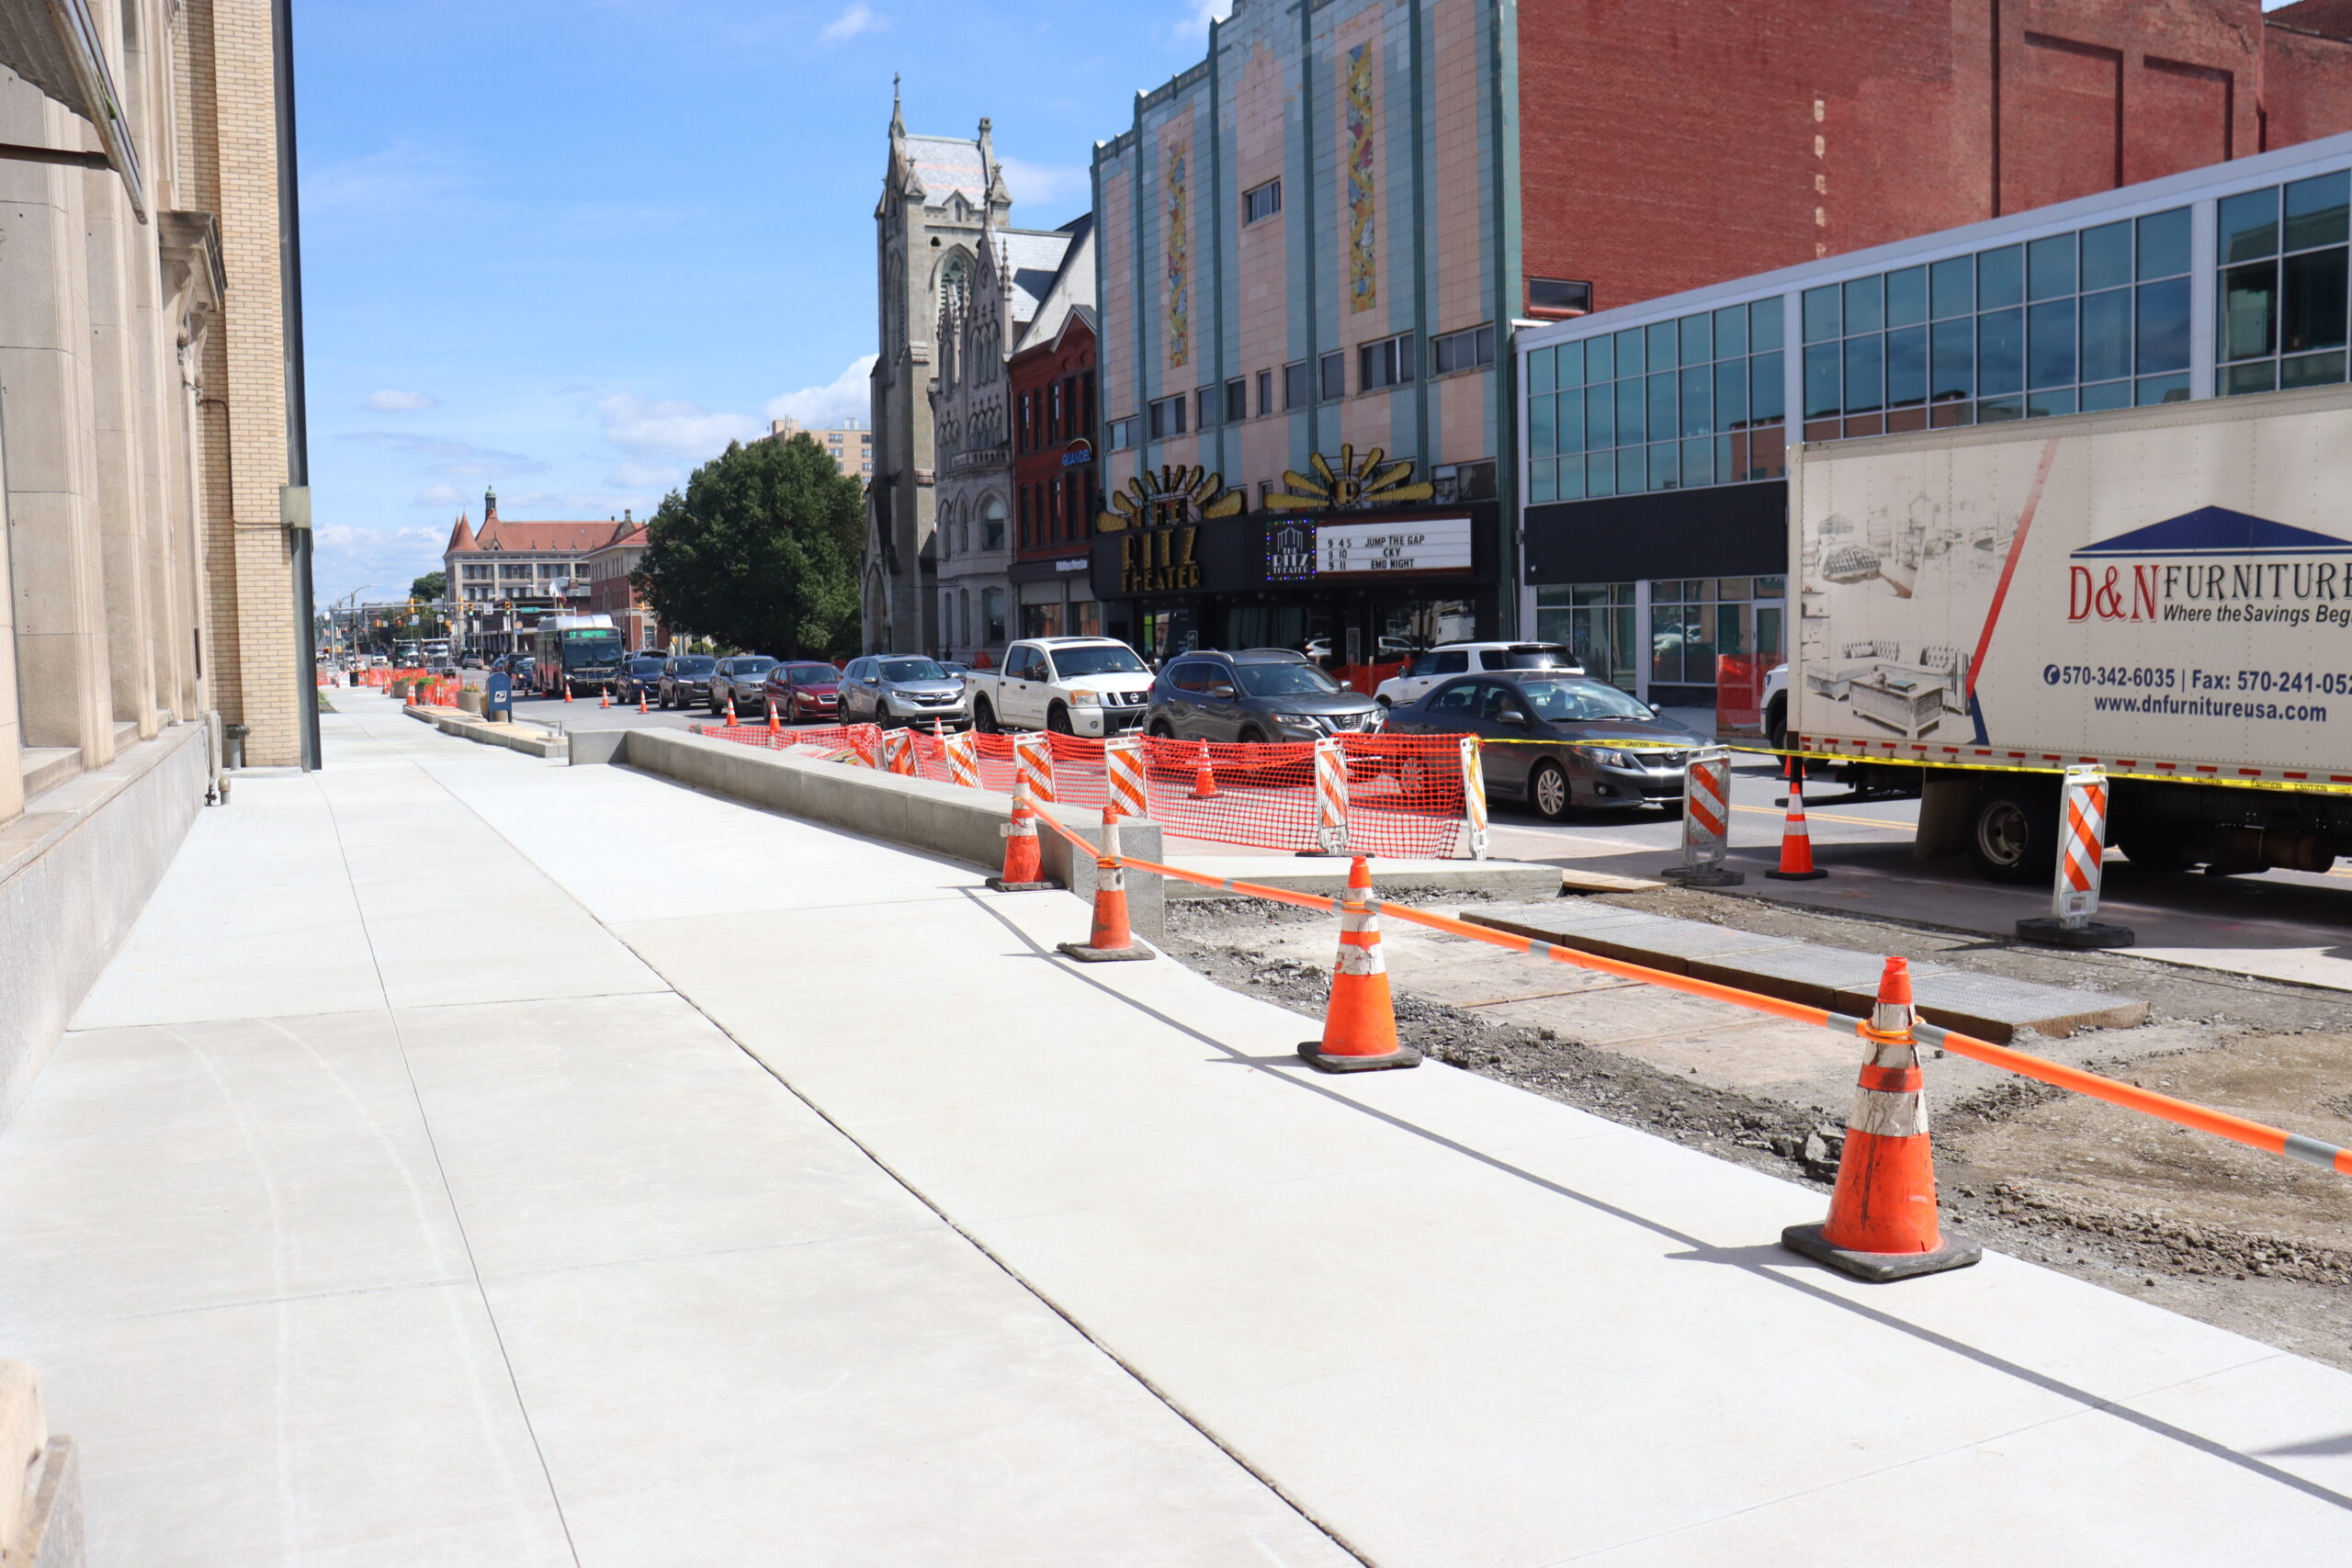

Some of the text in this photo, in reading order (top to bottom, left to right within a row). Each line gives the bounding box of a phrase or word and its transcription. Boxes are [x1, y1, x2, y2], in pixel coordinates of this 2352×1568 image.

[1062, 449, 1091, 466] QUANDEL
[1122, 526, 1196, 570] RITZ
[1340, 549, 1347, 558] 10
[1384, 547, 1401, 558] CKY
[1365, 537, 1385, 547] JUMP
[1388, 536, 1404, 546] THE
[1408, 535, 1425, 545] GAP
[1272, 554, 1308, 567] RITZ
[1371, 559, 1387, 570] EMO
[1390, 558, 1414, 569] NIGHT
[1120, 565, 1200, 592] THEATER
[2067, 564, 2162, 624] D&N
[2163, 604, 2352, 627] Where the Savings Beg
[2063, 665, 2175, 688] 570-342-6035
[2192, 669, 2230, 690] Fax:
[2094, 694, 2327, 723] www.dnfurnitureusa.com
